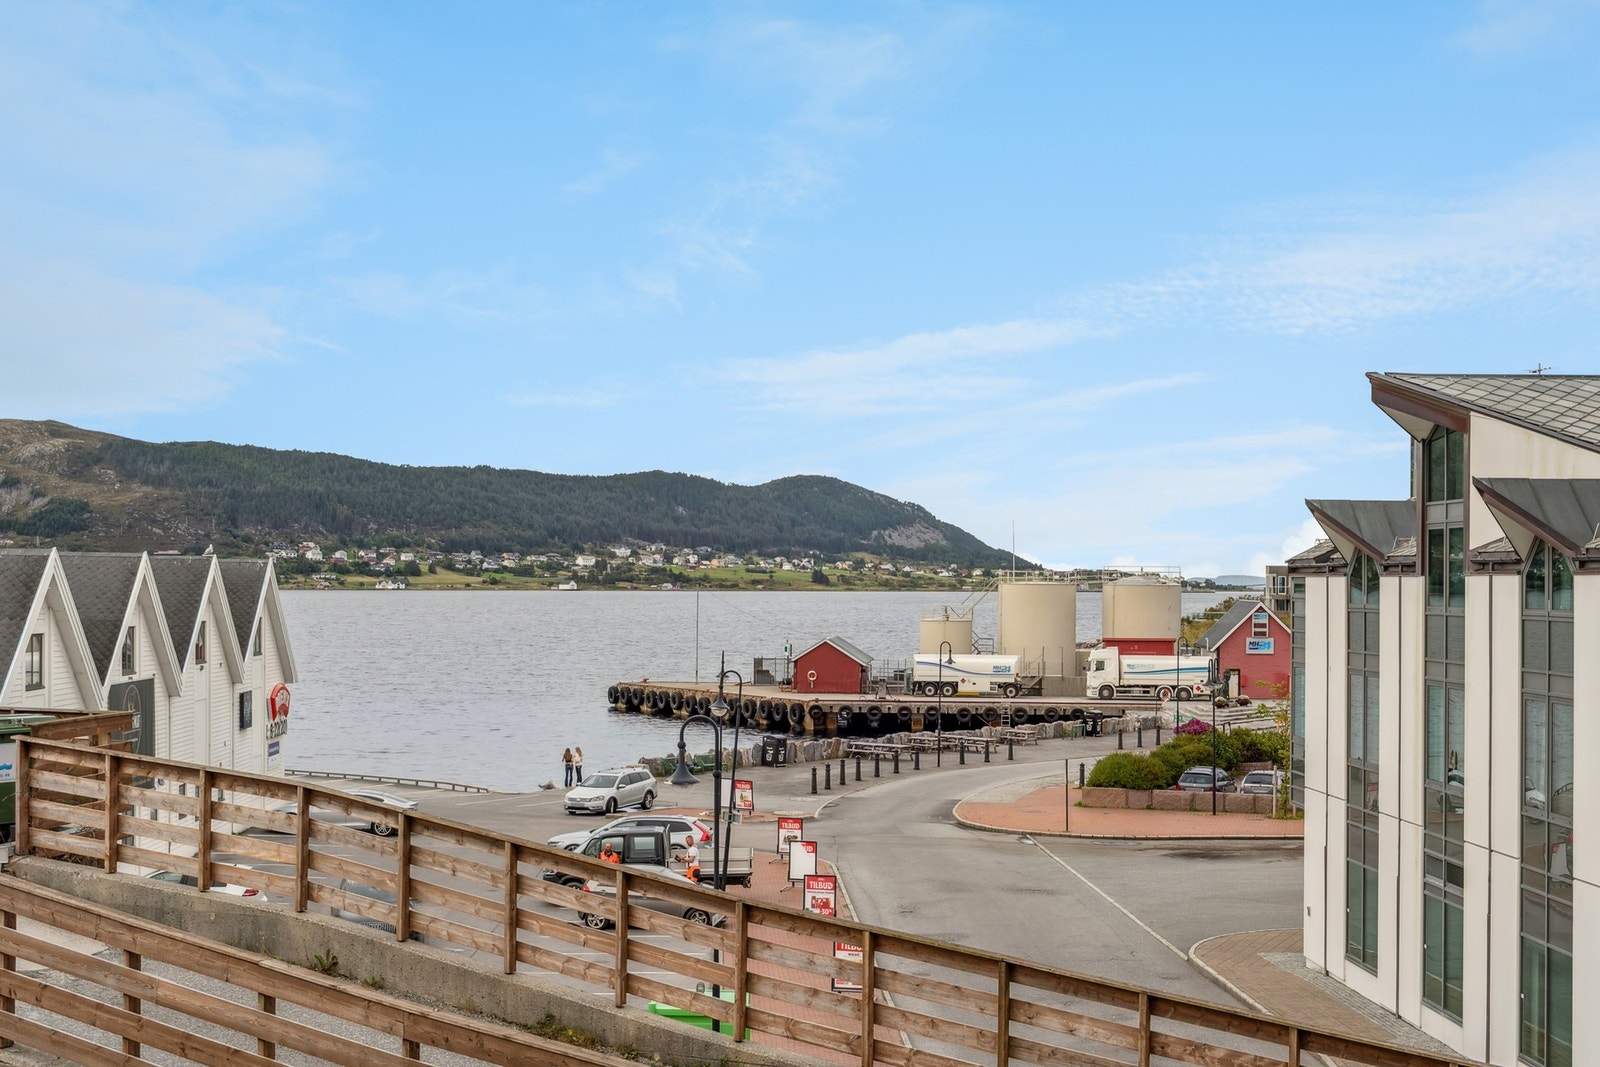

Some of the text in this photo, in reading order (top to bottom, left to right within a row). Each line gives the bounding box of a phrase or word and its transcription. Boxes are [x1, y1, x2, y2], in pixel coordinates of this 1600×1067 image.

[781, 822, 800, 830] TILBUD
[809, 880, 833, 890] TILBUD
[841, 943, 863, 951] TILB
